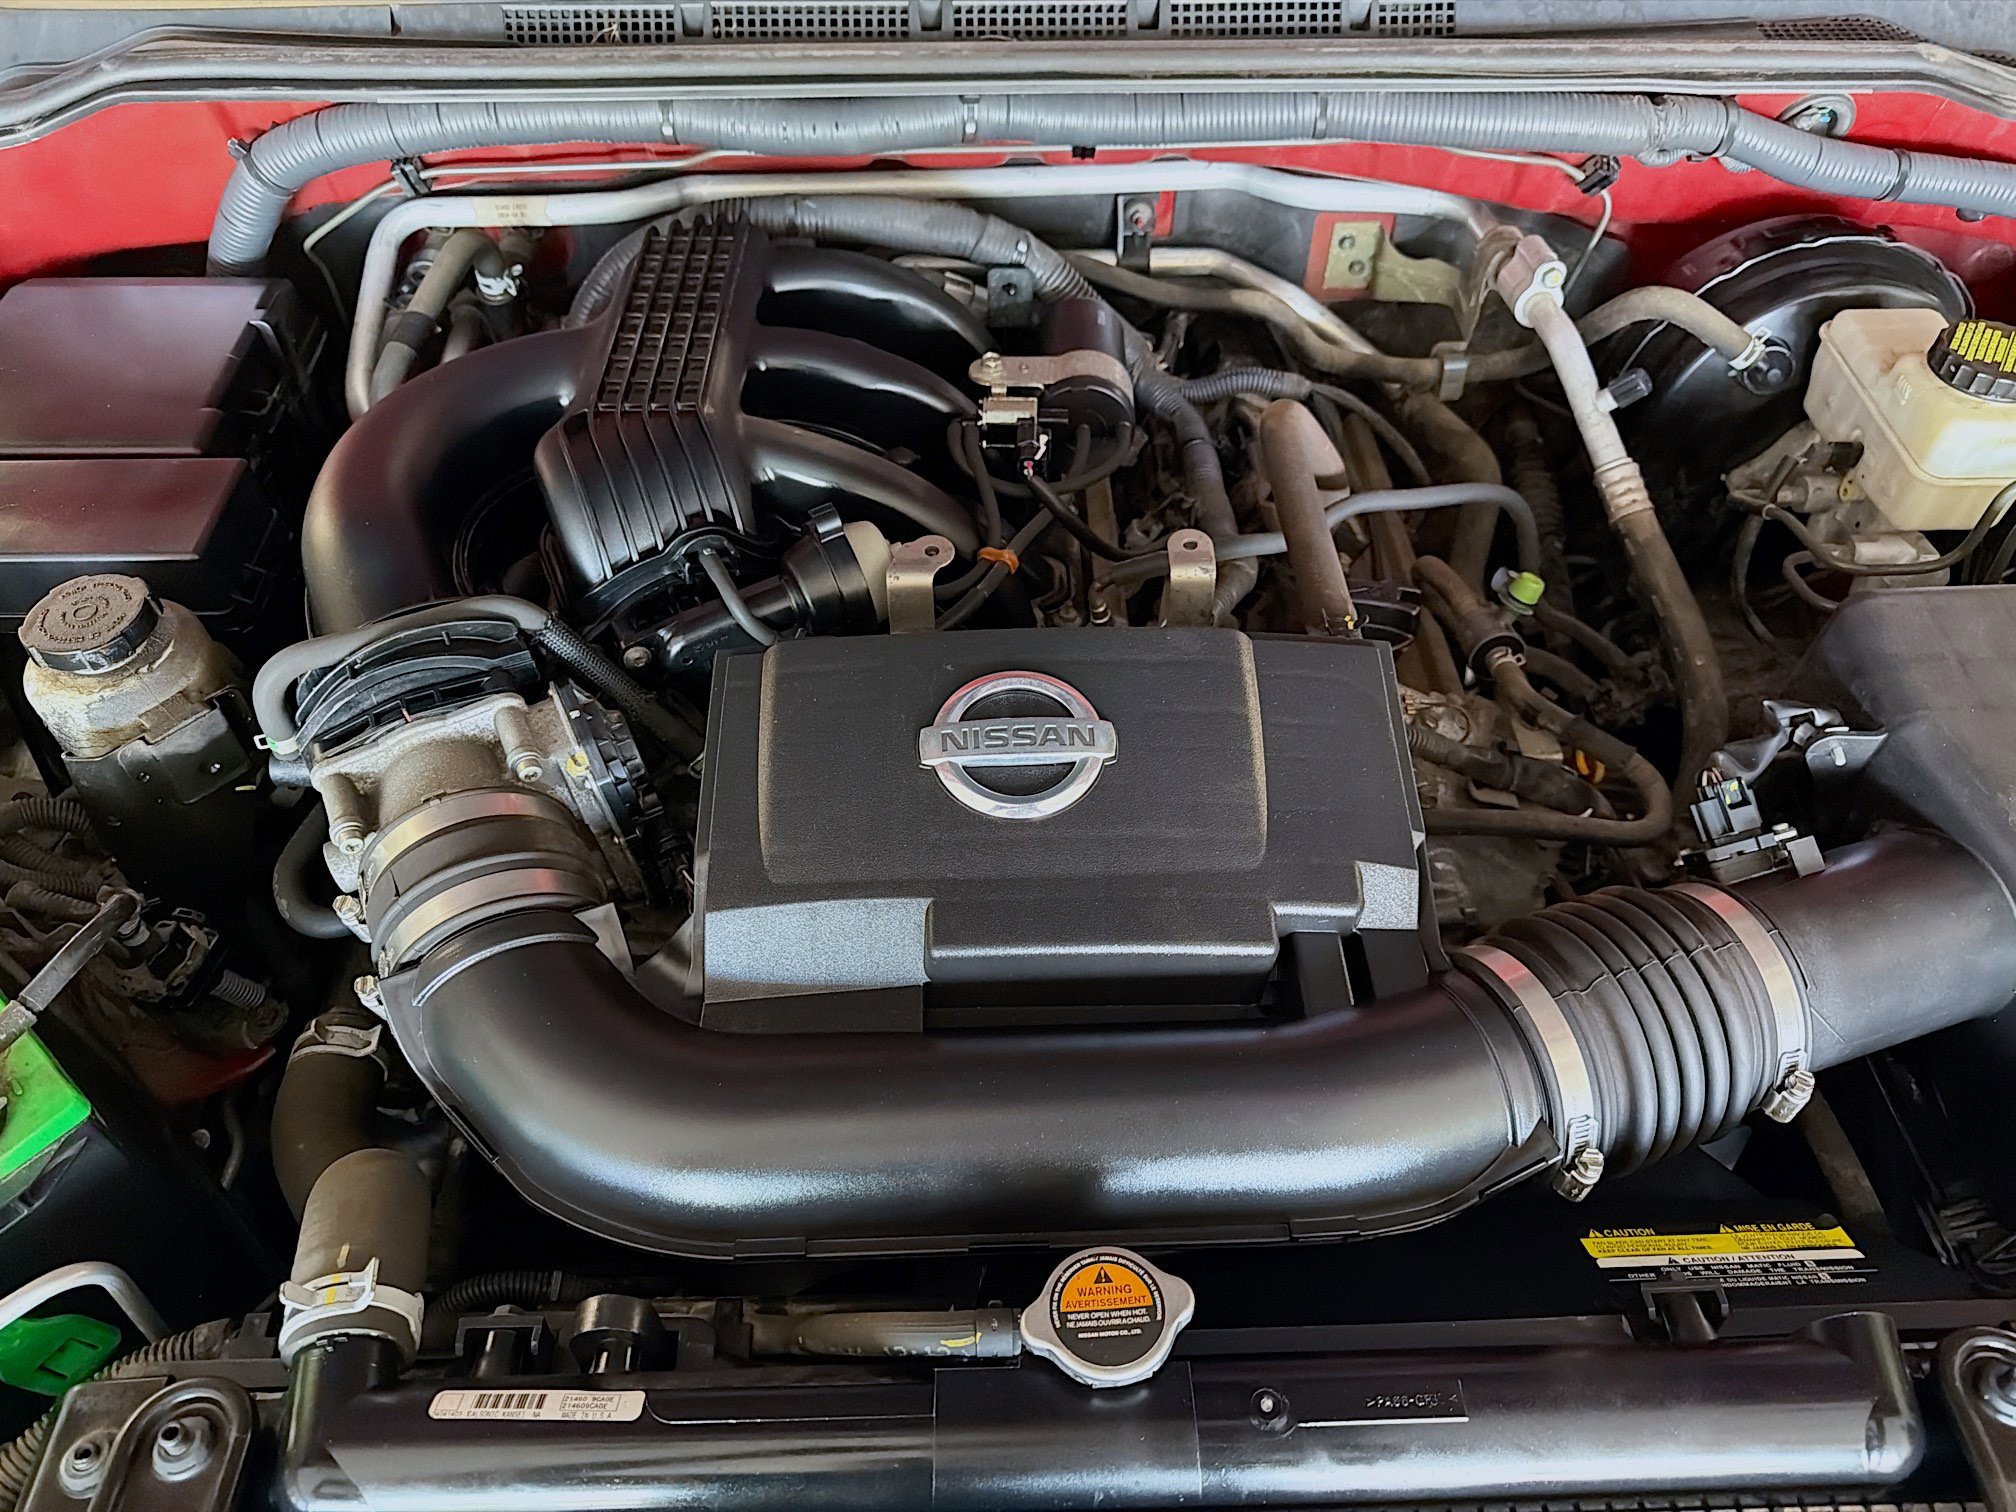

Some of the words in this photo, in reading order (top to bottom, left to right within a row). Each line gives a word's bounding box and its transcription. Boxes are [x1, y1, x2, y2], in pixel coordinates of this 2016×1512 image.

[941, 724, 1095, 752] NISSAN
[1604, 1228, 1656, 1238] CAUTION
[1733, 1224, 1758, 1232] MISE
[1760, 1223, 1776, 1232] EN
[1777, 1222, 1816, 1231] GARDE
[1077, 1284, 1132, 1297] WARNING
[1066, 1296, 1148, 1309] AVERTISSEMENT
[1067, 1312, 1090, 1320] NEVER
[1091, 1311, 1110, 1319] OPEN
[1110, 1309, 1132, 1318] WHEN
[1133, 1308, 1148, 1316] HOT.
[1076, 1319, 1097, 1328] JAMAIS
[1098, 1318, 1122, 1326] OUVRIR
